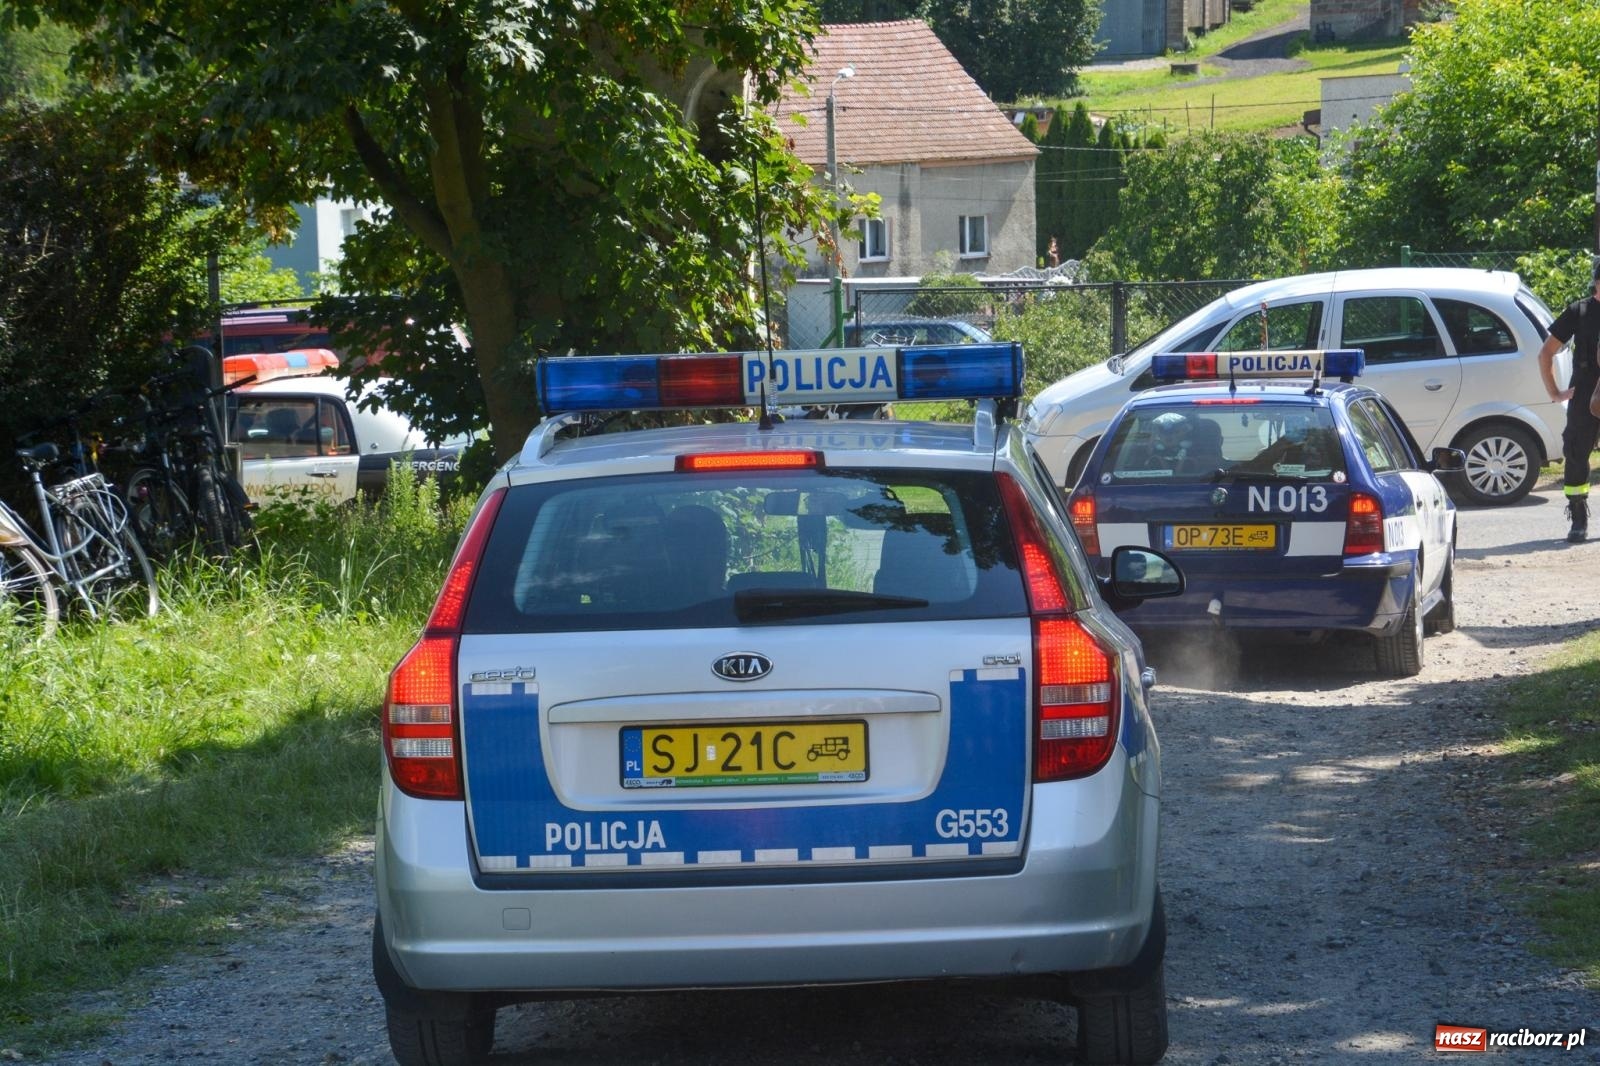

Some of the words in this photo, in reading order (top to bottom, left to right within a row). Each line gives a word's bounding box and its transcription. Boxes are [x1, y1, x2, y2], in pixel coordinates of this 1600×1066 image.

[1229, 355, 1312, 372] POLICJA
[747, 355, 893, 393] POLICJA
[395, 460, 461, 472] EMERGENC
[1176, 527, 1201, 546] OP
[1208, 527, 1244, 546] 73E
[722, 658, 763, 675] KIA
[651, 732, 699, 774] SJ
[720, 731, 796, 772] 21C
[626, 760, 641, 771] PL
[935, 808, 1009, 839] G553
[545, 820, 667, 851] POLICJA
